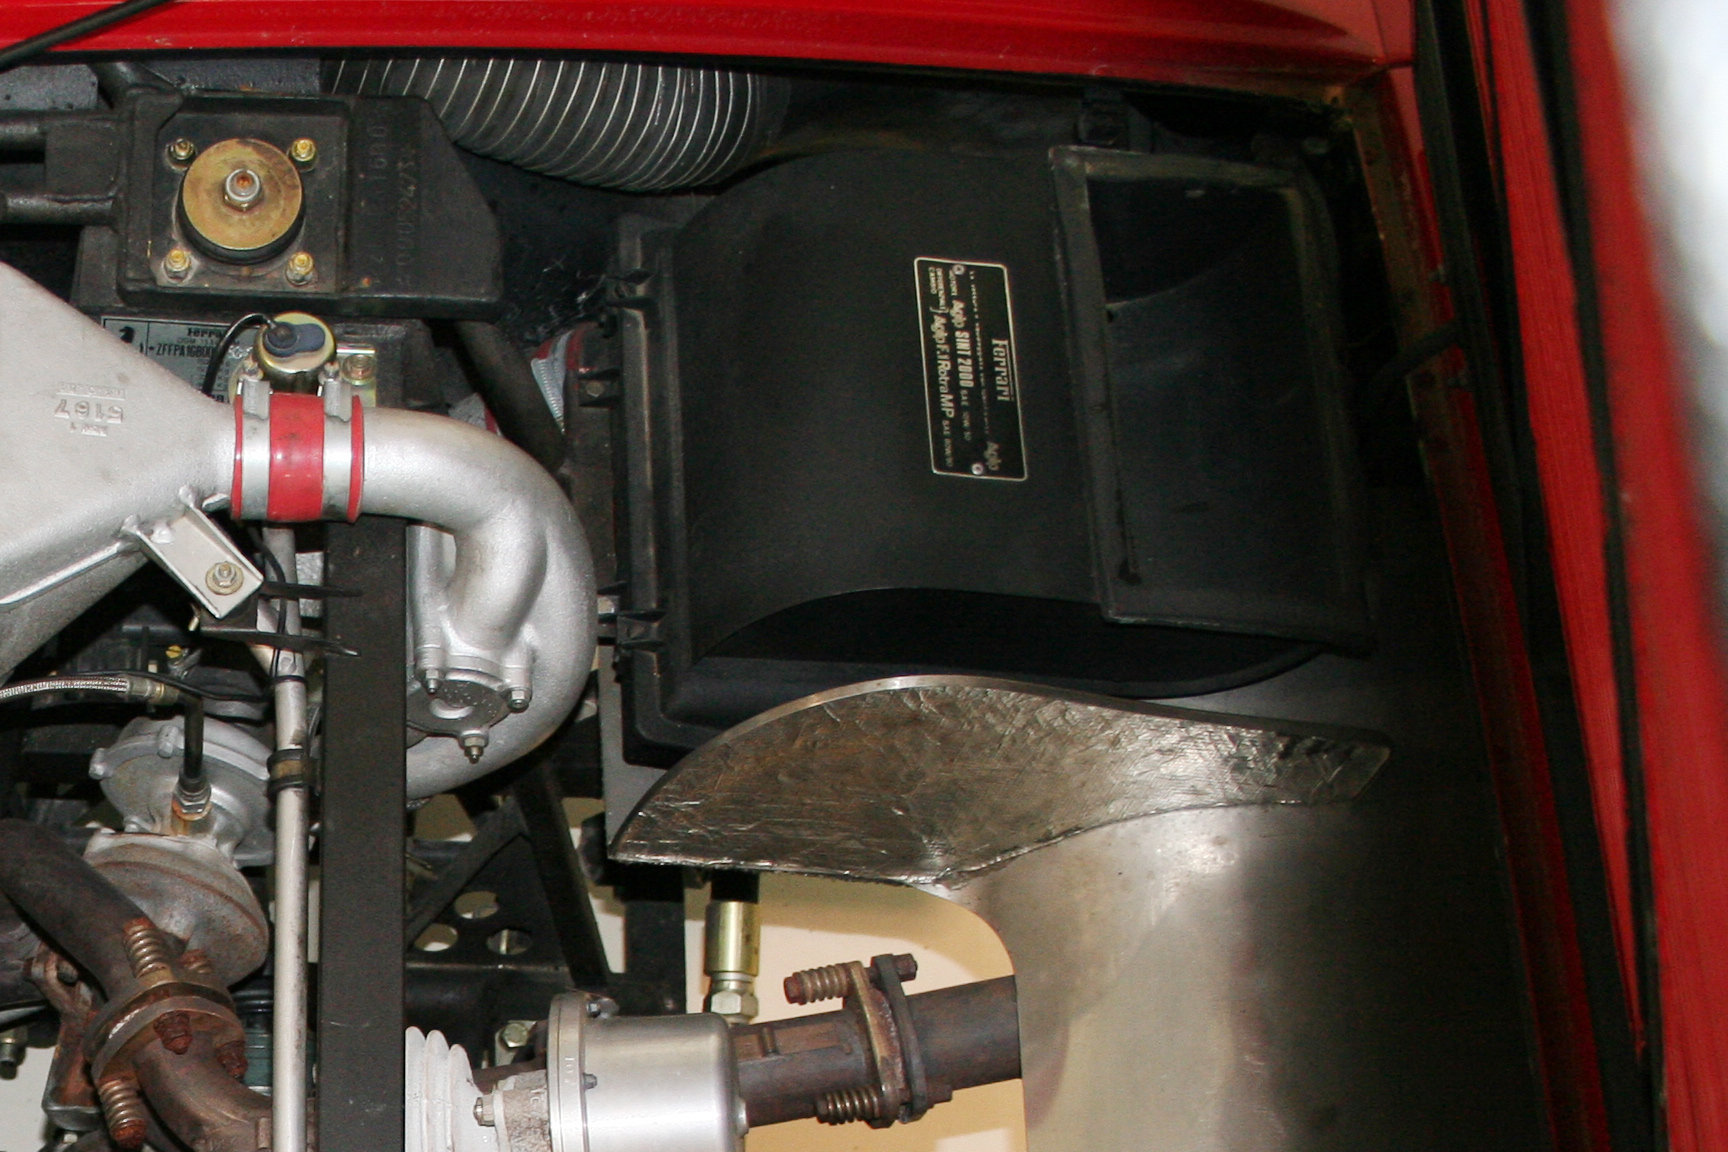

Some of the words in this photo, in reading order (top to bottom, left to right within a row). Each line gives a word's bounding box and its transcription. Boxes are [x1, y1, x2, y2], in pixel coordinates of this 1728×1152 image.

[950, 300, 967, 328] Agip
[955, 331, 972, 356] SINT
[931, 314, 948, 344] Agip
[940, 394, 955, 418] MP
[957, 358, 974, 388] 2000
[992, 339, 1014, 401] Ferrari
[54, 399, 124, 424] 5167
[983, 441, 1003, 471] Agip
